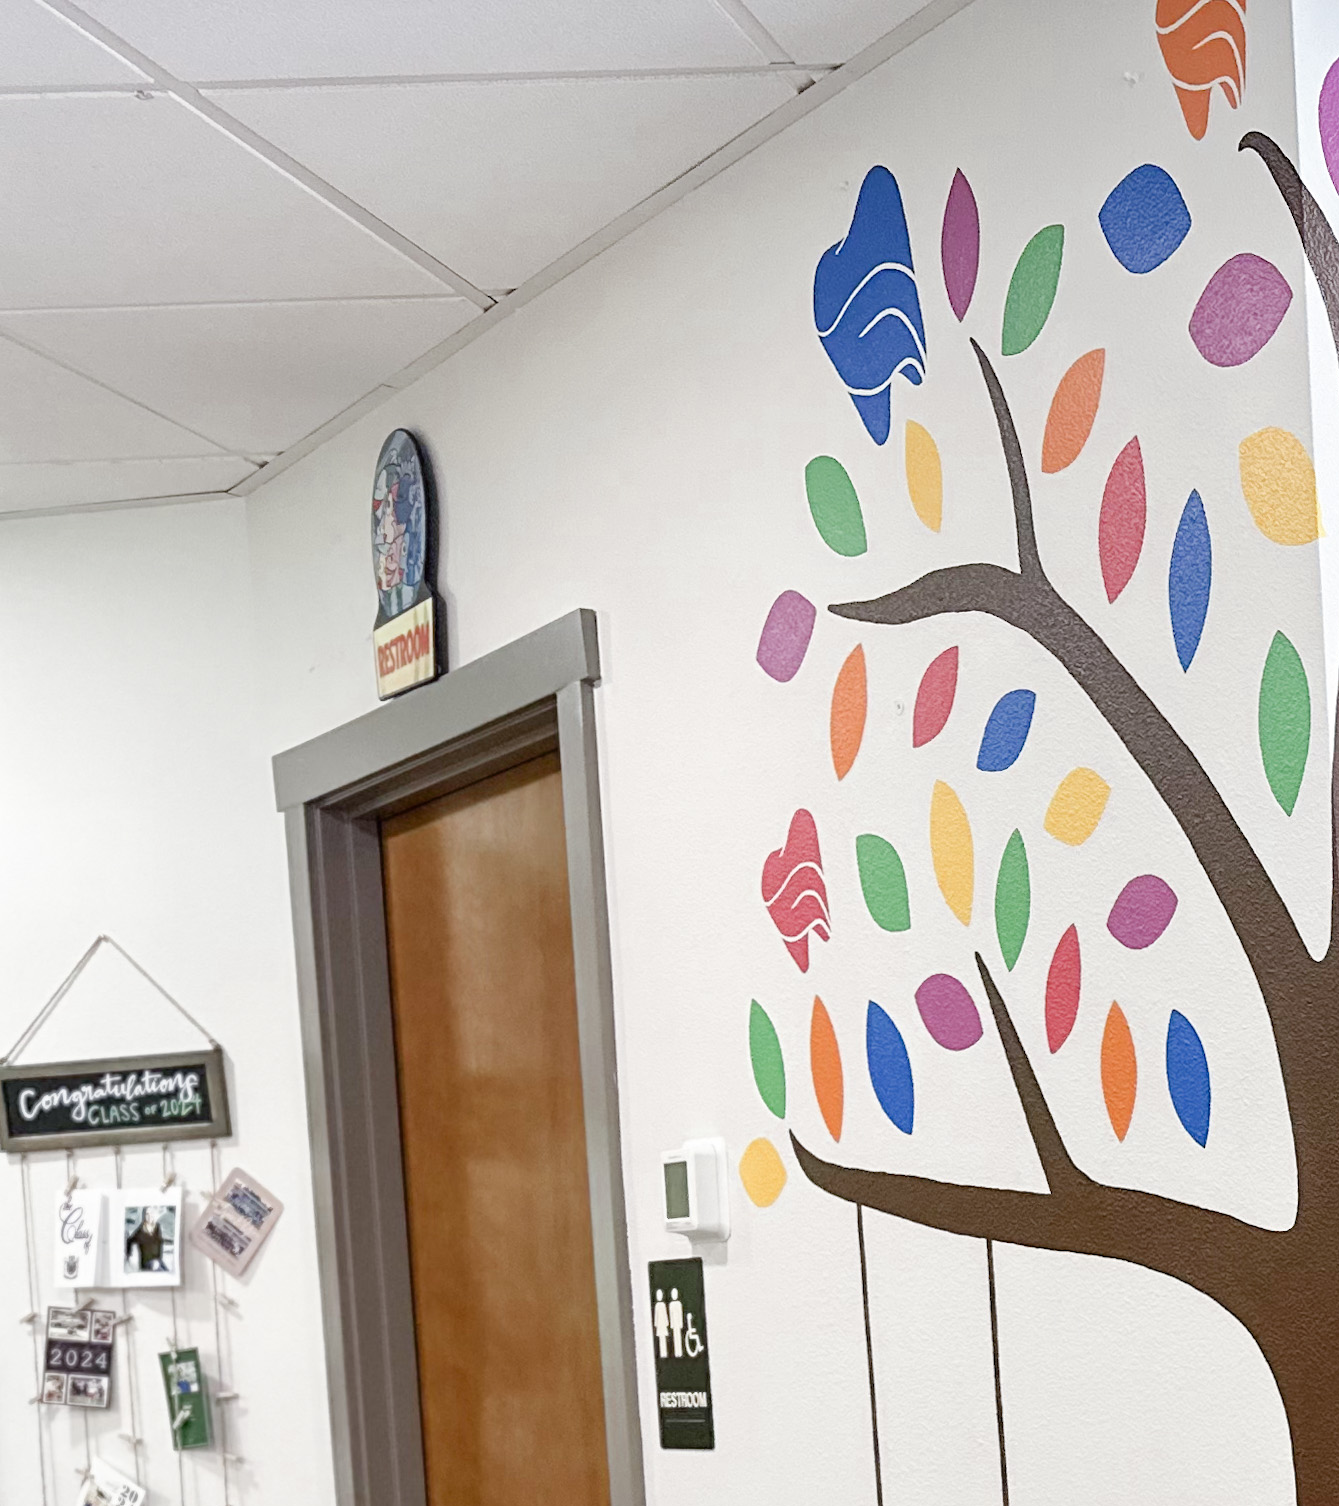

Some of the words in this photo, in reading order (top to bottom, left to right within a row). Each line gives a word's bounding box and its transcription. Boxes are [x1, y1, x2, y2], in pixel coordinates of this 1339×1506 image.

[378, 621, 430, 678] RESTROOM
[19, 1071, 199, 1121] Congratulations
[87, 1102, 140, 1125] CLASS
[160, 1093, 202, 1118] 2024
[50, 1348, 107, 1369] 2024
[660, 1391, 708, 1408] RESTROOM
